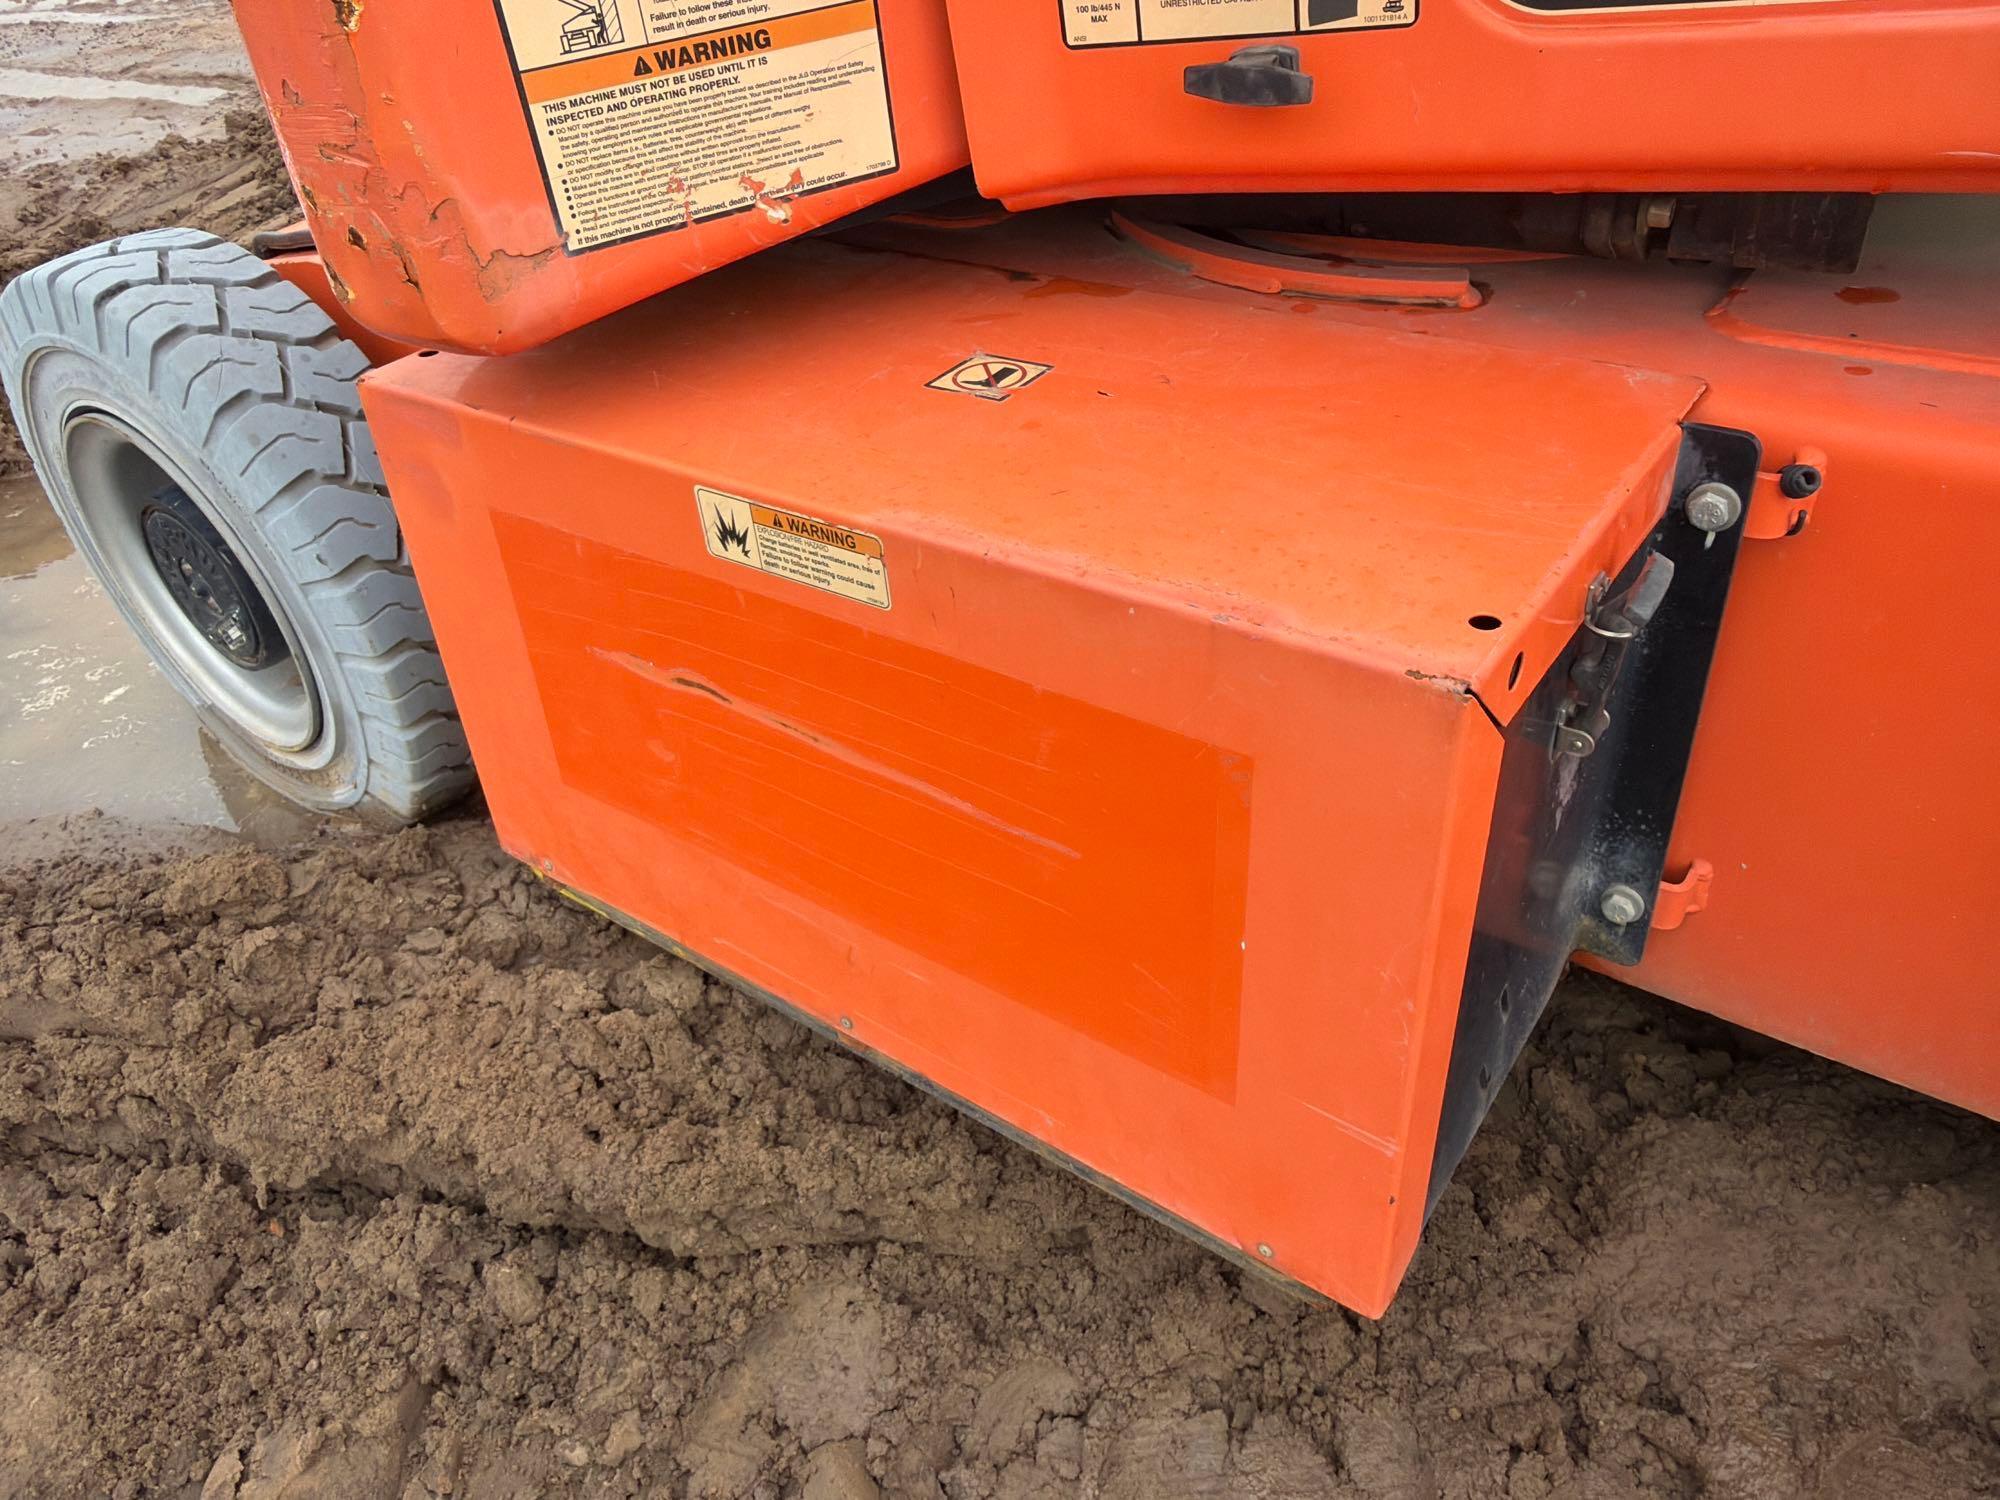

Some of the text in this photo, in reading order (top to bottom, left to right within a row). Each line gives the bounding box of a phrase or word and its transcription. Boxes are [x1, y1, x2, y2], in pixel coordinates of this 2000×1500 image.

[650, 11, 677, 22] Failure
[688, 4, 711, 15] follow
[712, 0, 733, 9] these
[653, 22, 675, 34] result
[686, 15, 707, 26] death
[718, 8, 746, 20] serious
[747, 4, 771, 14] injury.
[1090, 4, 1113, 13] lb/445
[1091, 15, 1108, 23] MAX
[655, 29, 771, 71] WARNING
[542, 57, 768, 114] THIS MACHINE MUST NOT BE USED UNTIL IT IS
[546, 76, 740, 127] INSPECTED AND OPERATING PROPERLY.
[617, 112, 641, 120] machine
[656, 153, 679, 162] machine
[719, 172, 739, 181] Manual
[576, 200, 595, 208] Check
[584, 234, 599, 243] this
[600, 227, 632, 239] machine
[641, 220, 654, 229] not
[655, 213, 685, 226] properly
[729, 197, 748, 206] death
[806, 176, 825, 186] could
[827, 172, 847, 181] occur.
[787, 517, 856, 549] WARNING
